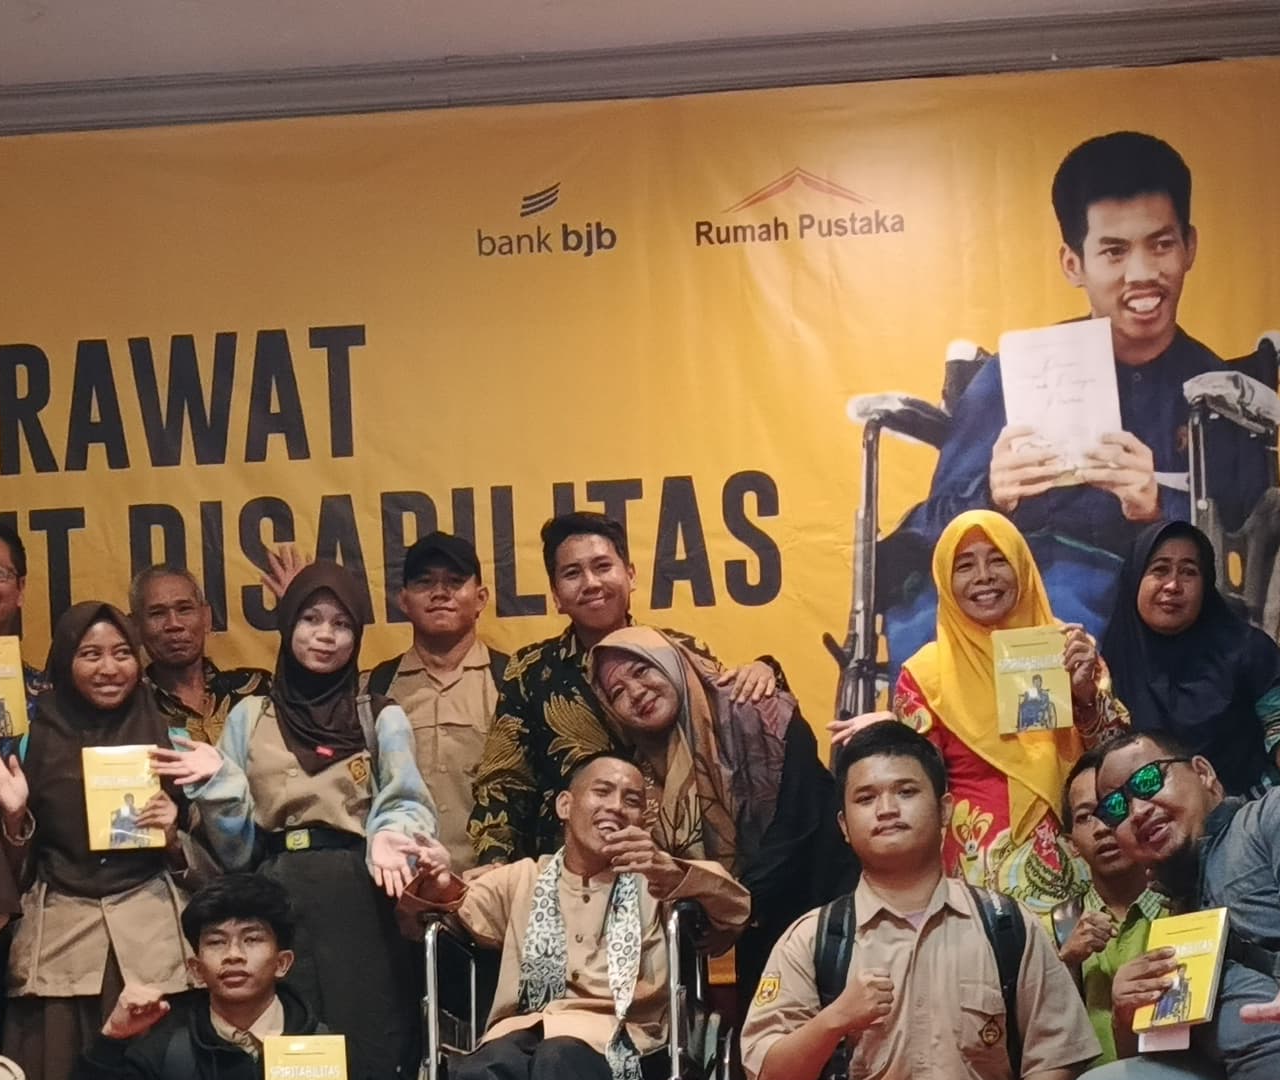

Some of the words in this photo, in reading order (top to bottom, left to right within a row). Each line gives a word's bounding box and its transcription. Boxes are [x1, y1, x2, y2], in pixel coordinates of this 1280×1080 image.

[476, 226, 554, 257] bank
[561, 221, 618, 258] bjb
[694, 216, 790, 247] Rumah
[797, 208, 906, 240] Pustaka
[128, 469, 783, 633] DISABLTAS
